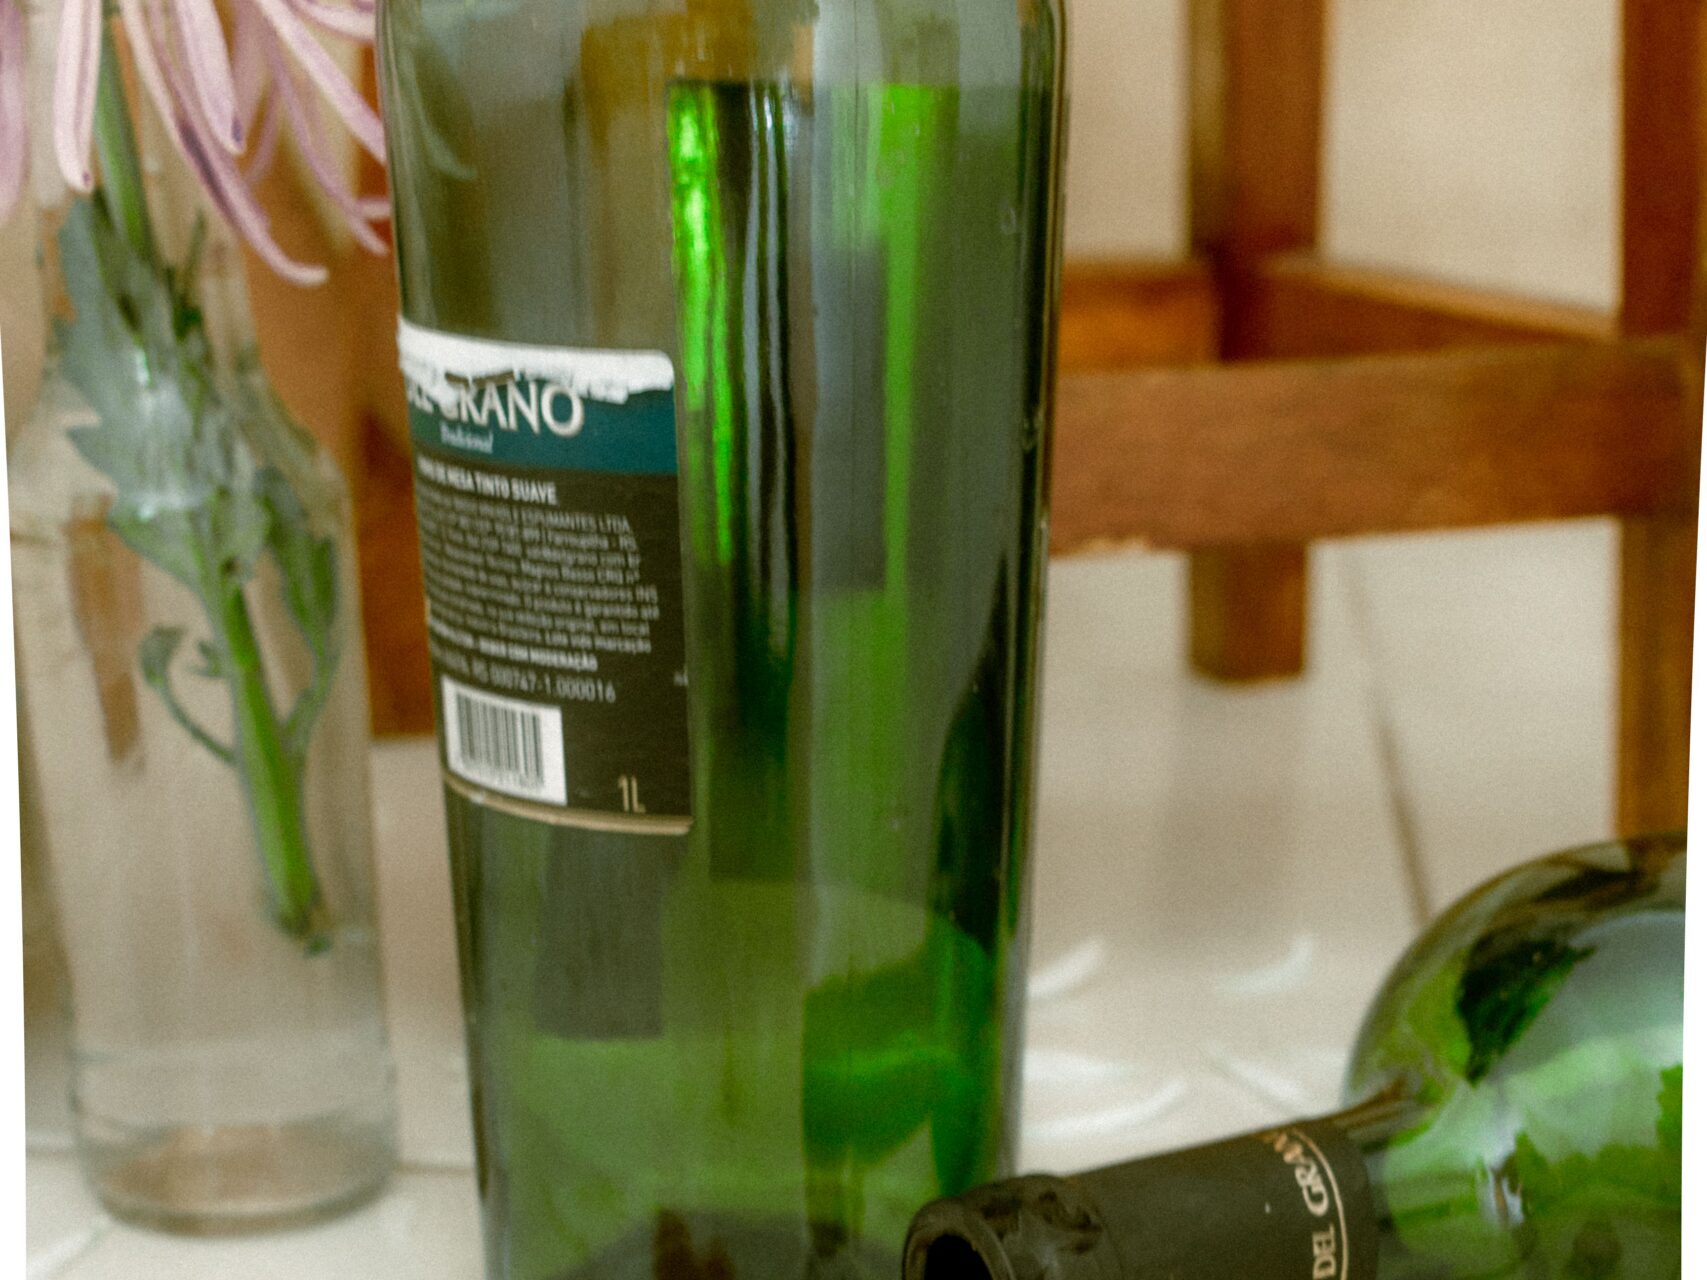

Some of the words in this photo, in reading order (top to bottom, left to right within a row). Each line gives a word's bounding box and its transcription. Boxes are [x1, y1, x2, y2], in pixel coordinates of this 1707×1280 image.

[474, 471, 511, 498] TINTO
[511, 479, 557, 506] SUAVE
[618, 774, 646, 813] 1L
[1266, 1132, 1330, 1218] GRAN
